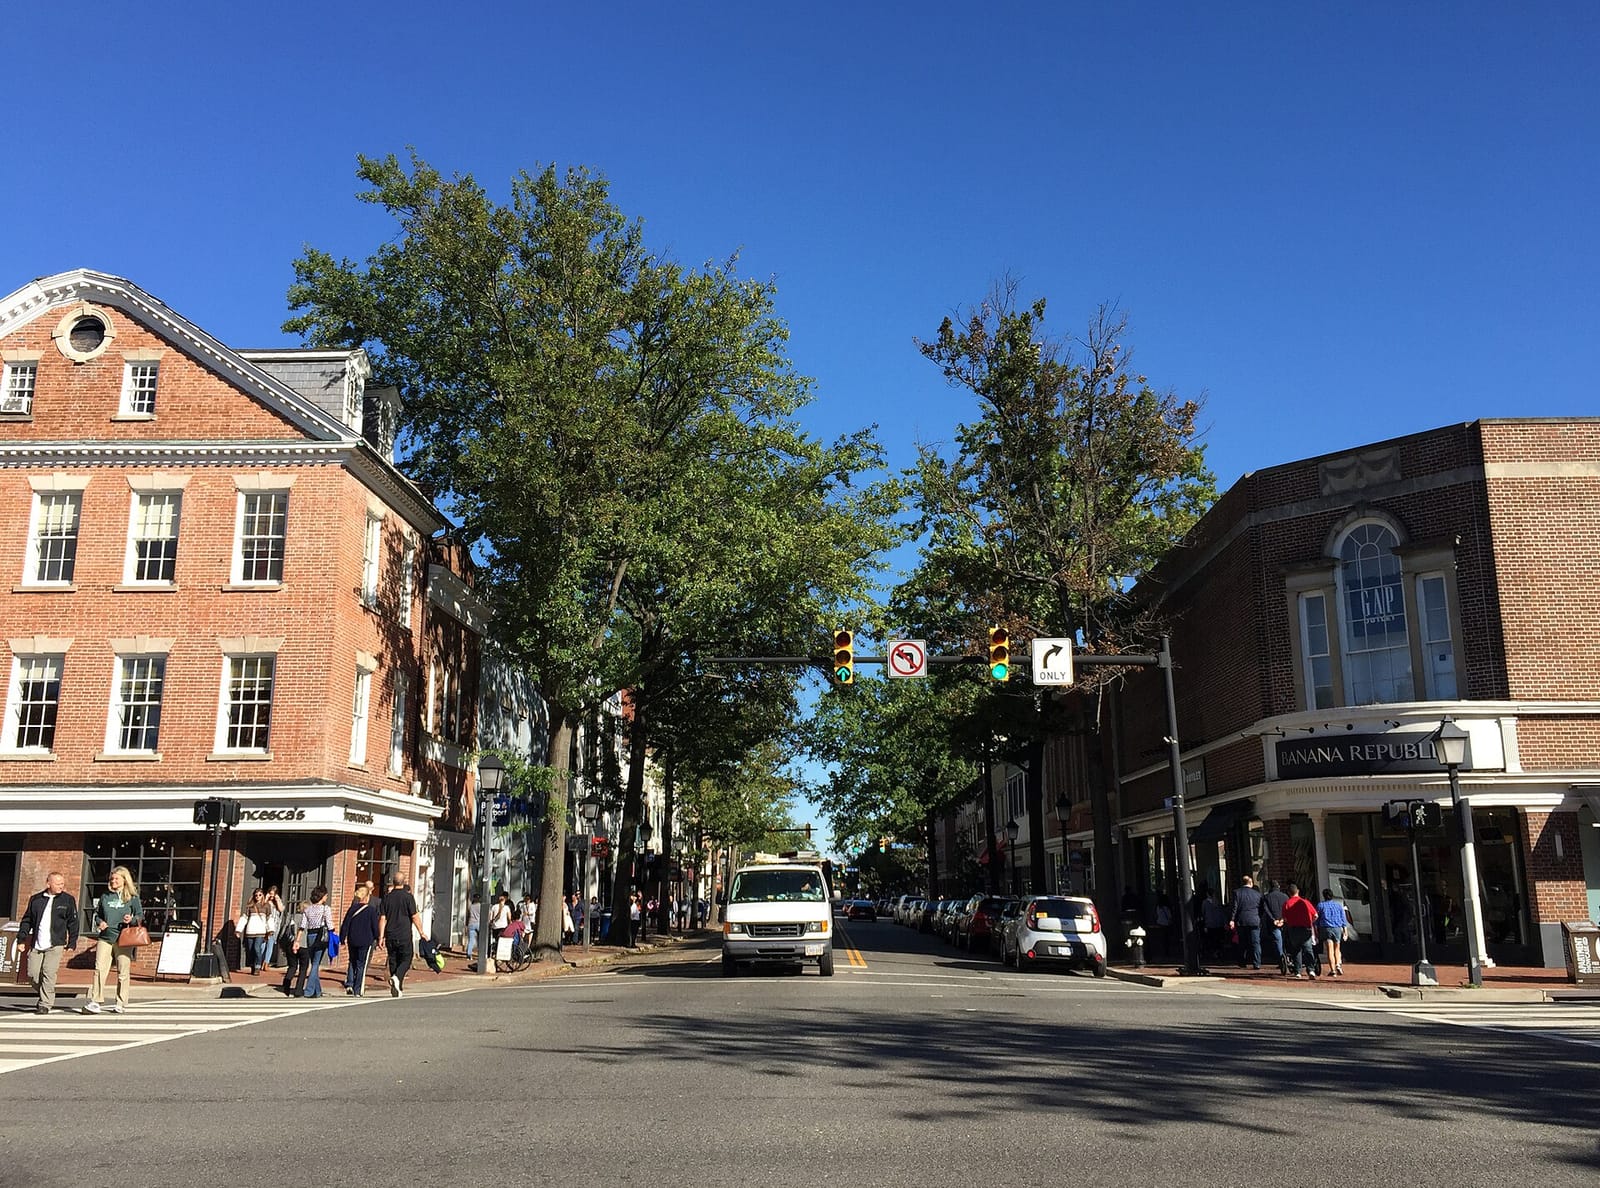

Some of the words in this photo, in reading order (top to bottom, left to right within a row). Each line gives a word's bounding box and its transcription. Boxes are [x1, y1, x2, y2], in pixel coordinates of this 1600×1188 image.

[1361, 586, 1394, 616] GAP
[1039, 671, 1066, 681] ONLY
[1281, 746, 1344, 766] BANANA
[1350, 742, 1437, 761] REPUBLI
[240, 806, 306, 821] ncesca's
